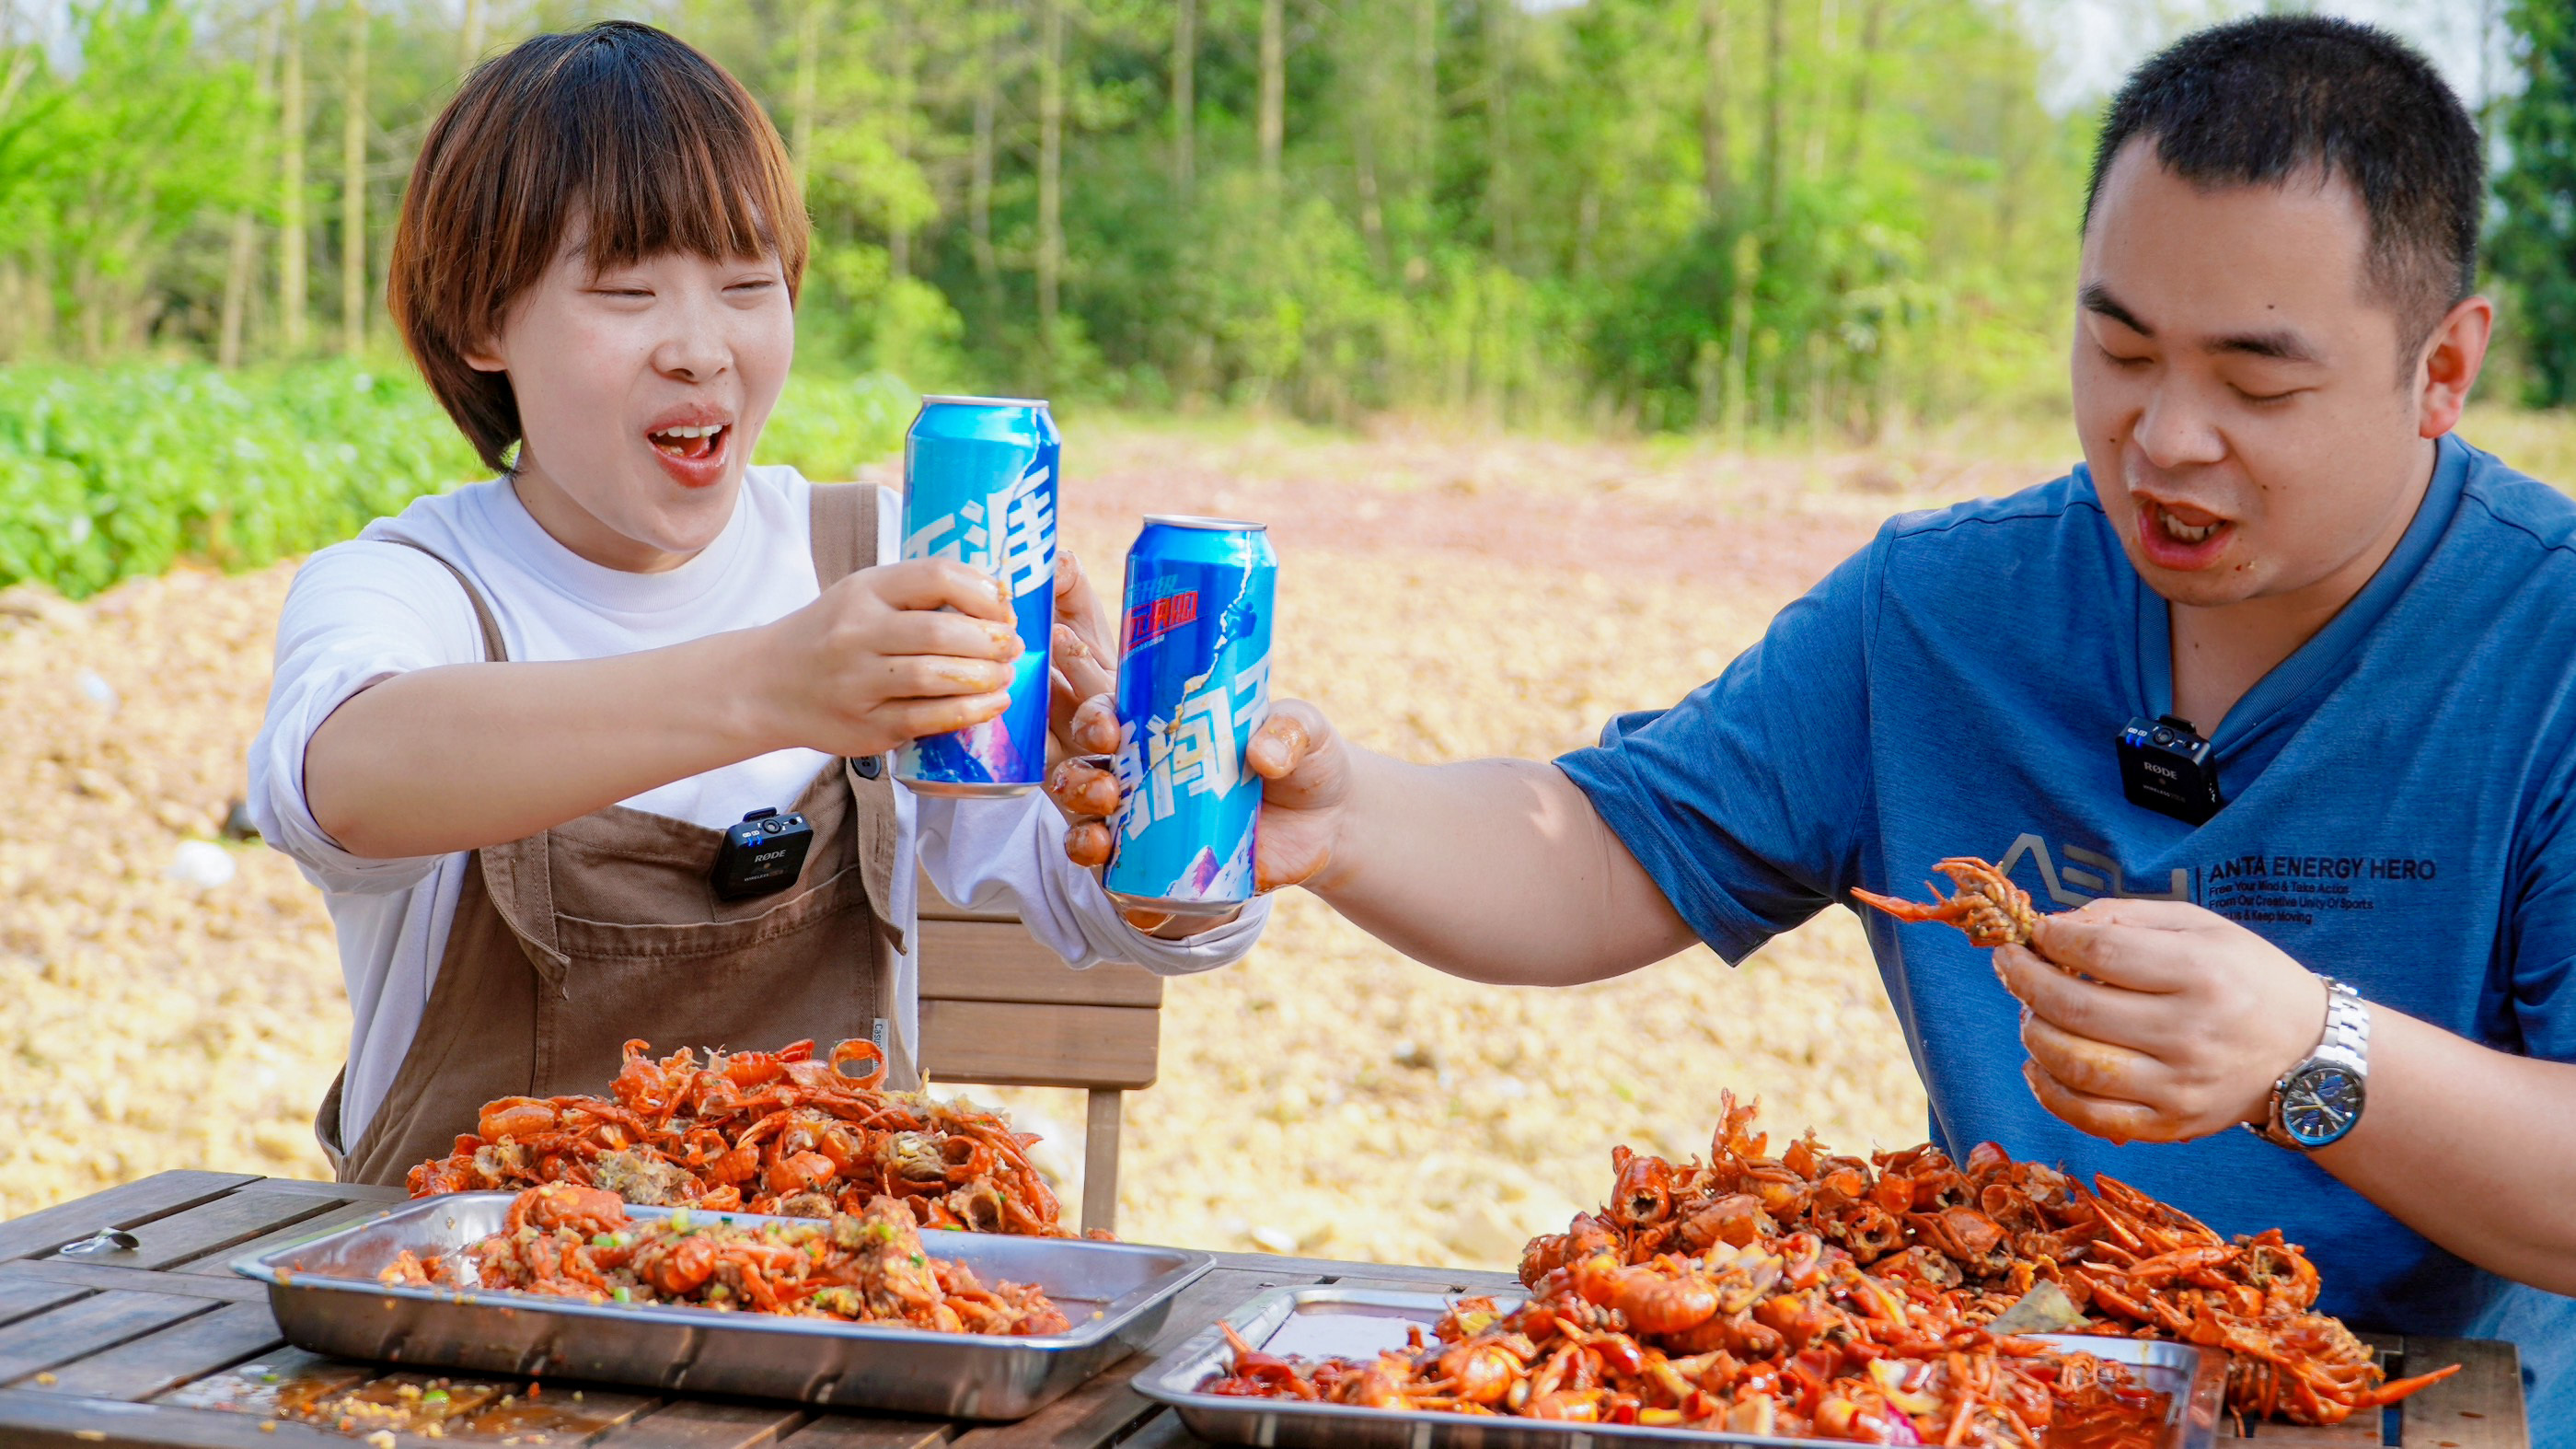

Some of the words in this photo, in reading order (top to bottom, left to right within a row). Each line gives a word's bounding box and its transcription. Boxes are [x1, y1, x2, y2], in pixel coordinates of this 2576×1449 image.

[2209, 855, 2269, 883] ANTA
[2272, 855, 2364, 879] ENERGY
[2370, 857, 2437, 880] HERO
[2209, 885, 2233, 897] Free
[2234, 881, 2256, 892] Your
[2258, 880, 2280, 892] Mind
[2291, 881, 2315, 893] Take
[2209, 898, 2236, 910] From
[2256, 895, 2298, 908] Creative
[2340, 898, 2374, 911] Sports
